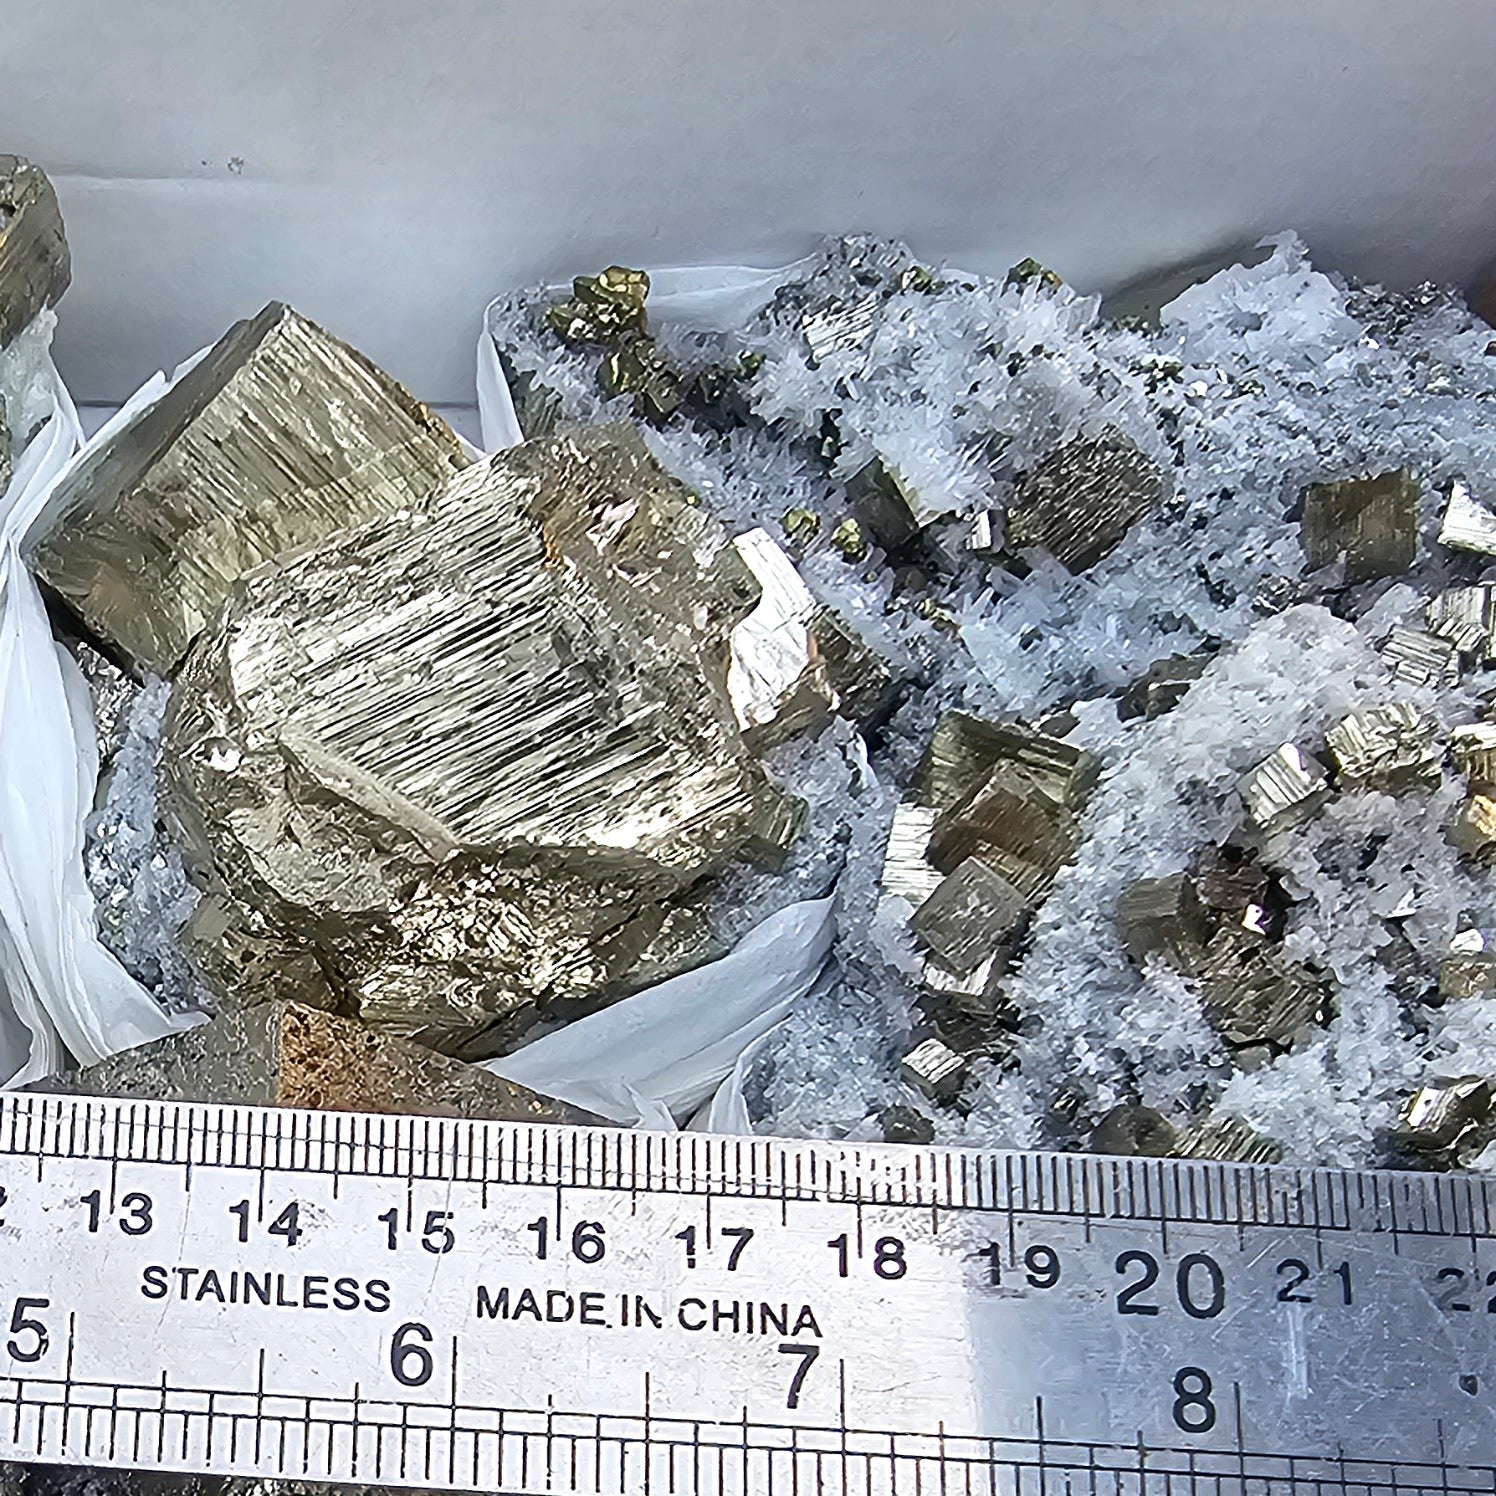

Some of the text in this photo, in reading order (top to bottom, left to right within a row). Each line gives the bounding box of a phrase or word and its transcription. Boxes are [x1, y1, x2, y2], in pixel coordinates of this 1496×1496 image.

[80, 1190, 154, 1236] 13
[229, 1200, 303, 1247] 14
[378, 1208, 455, 1255] 15
[527, 1216, 606, 1264] 16
[675, 1225, 754, 1272] 17
[827, 1234, 908, 1281] 18
[977, 1244, 1061, 1289] 19
[1115, 1250, 1226, 1320] 20
[1275, 1258, 1354, 1306] 21
[141, 1265, 391, 1312] STAINLESS
[476, 1285, 823, 1338] MADE IN CHINA
[8, 1298, 50, 1362] 5
[391, 1323, 434, 1387] 6
[778, 1344, 820, 1409] 7
[1173, 1367, 1216, 1433] 8
